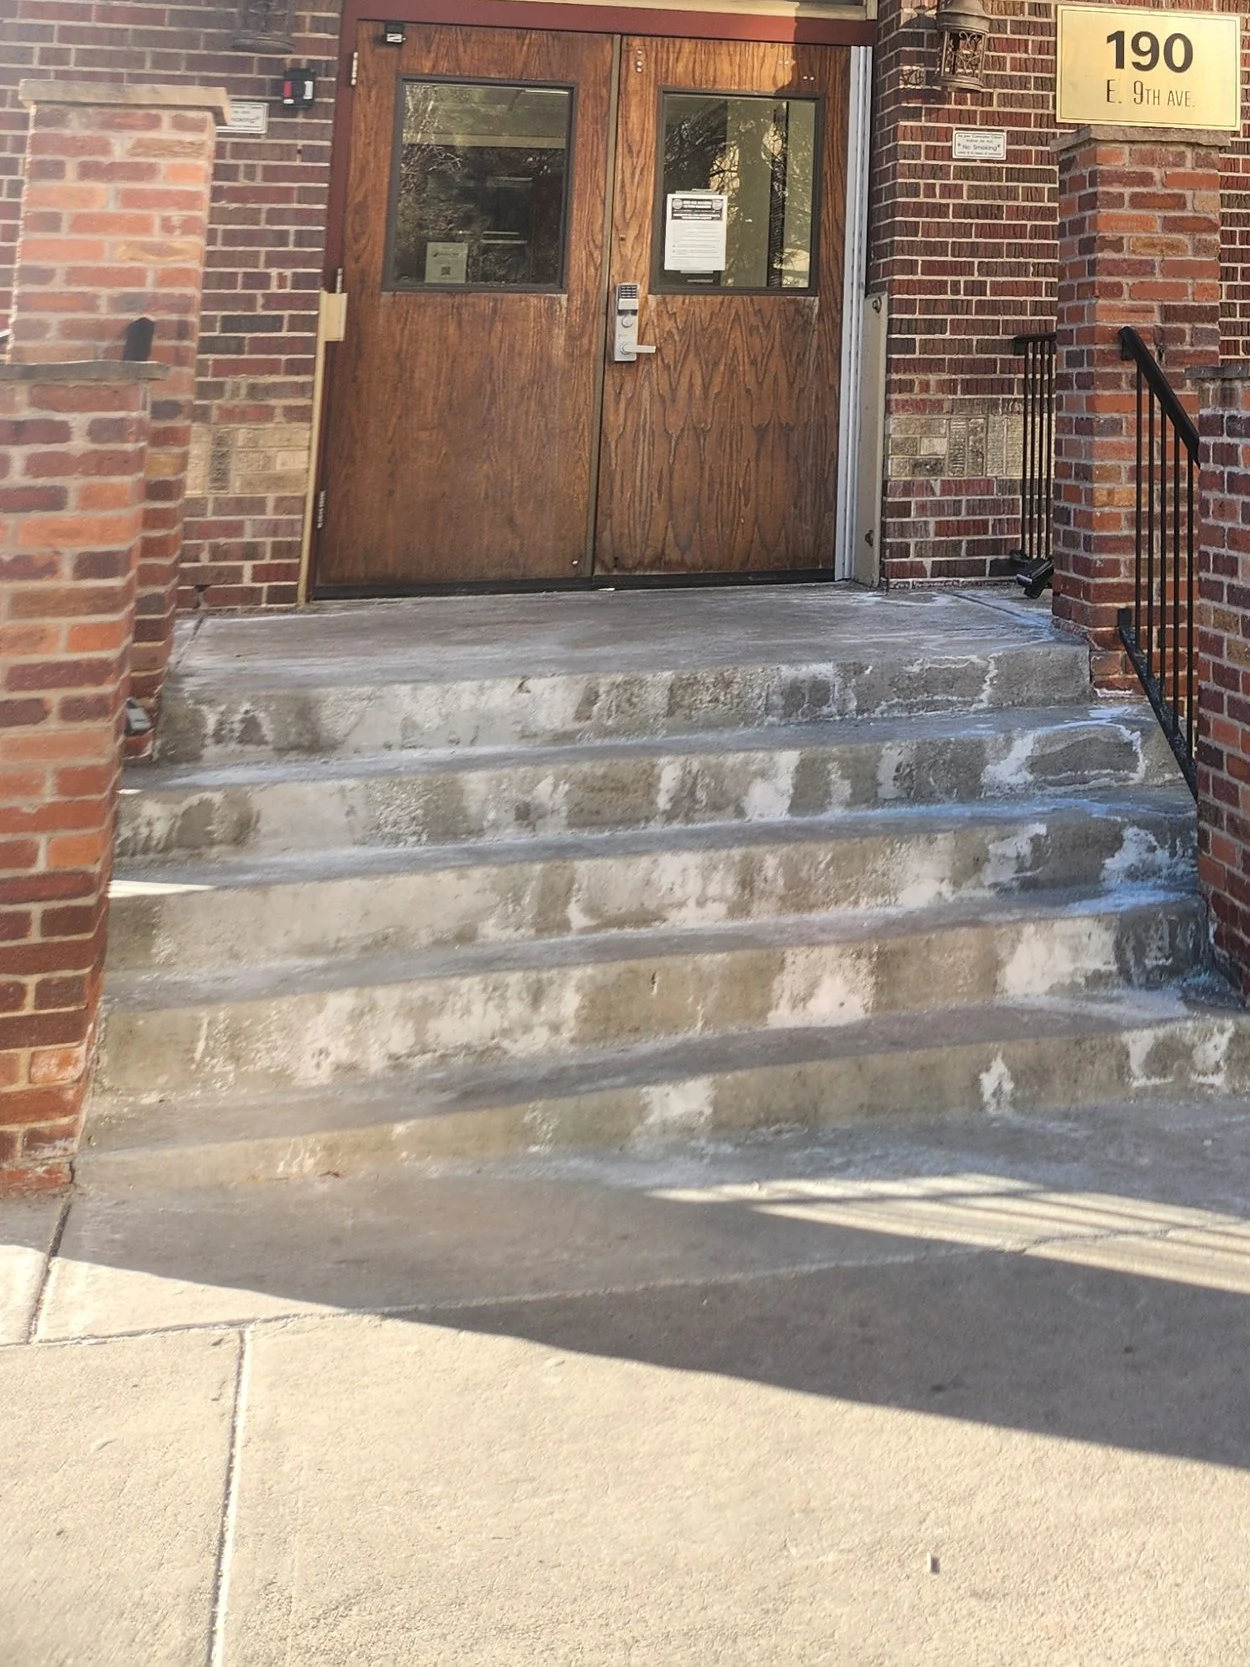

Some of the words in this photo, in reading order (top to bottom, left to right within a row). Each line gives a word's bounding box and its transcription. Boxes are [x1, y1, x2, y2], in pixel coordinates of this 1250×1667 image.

[1106, 30, 1194, 73] 190
[1106, 79, 1122, 104] E.
[1133, 80, 1160, 105] 9TH
[1167, 90, 1195, 107] AVE.
